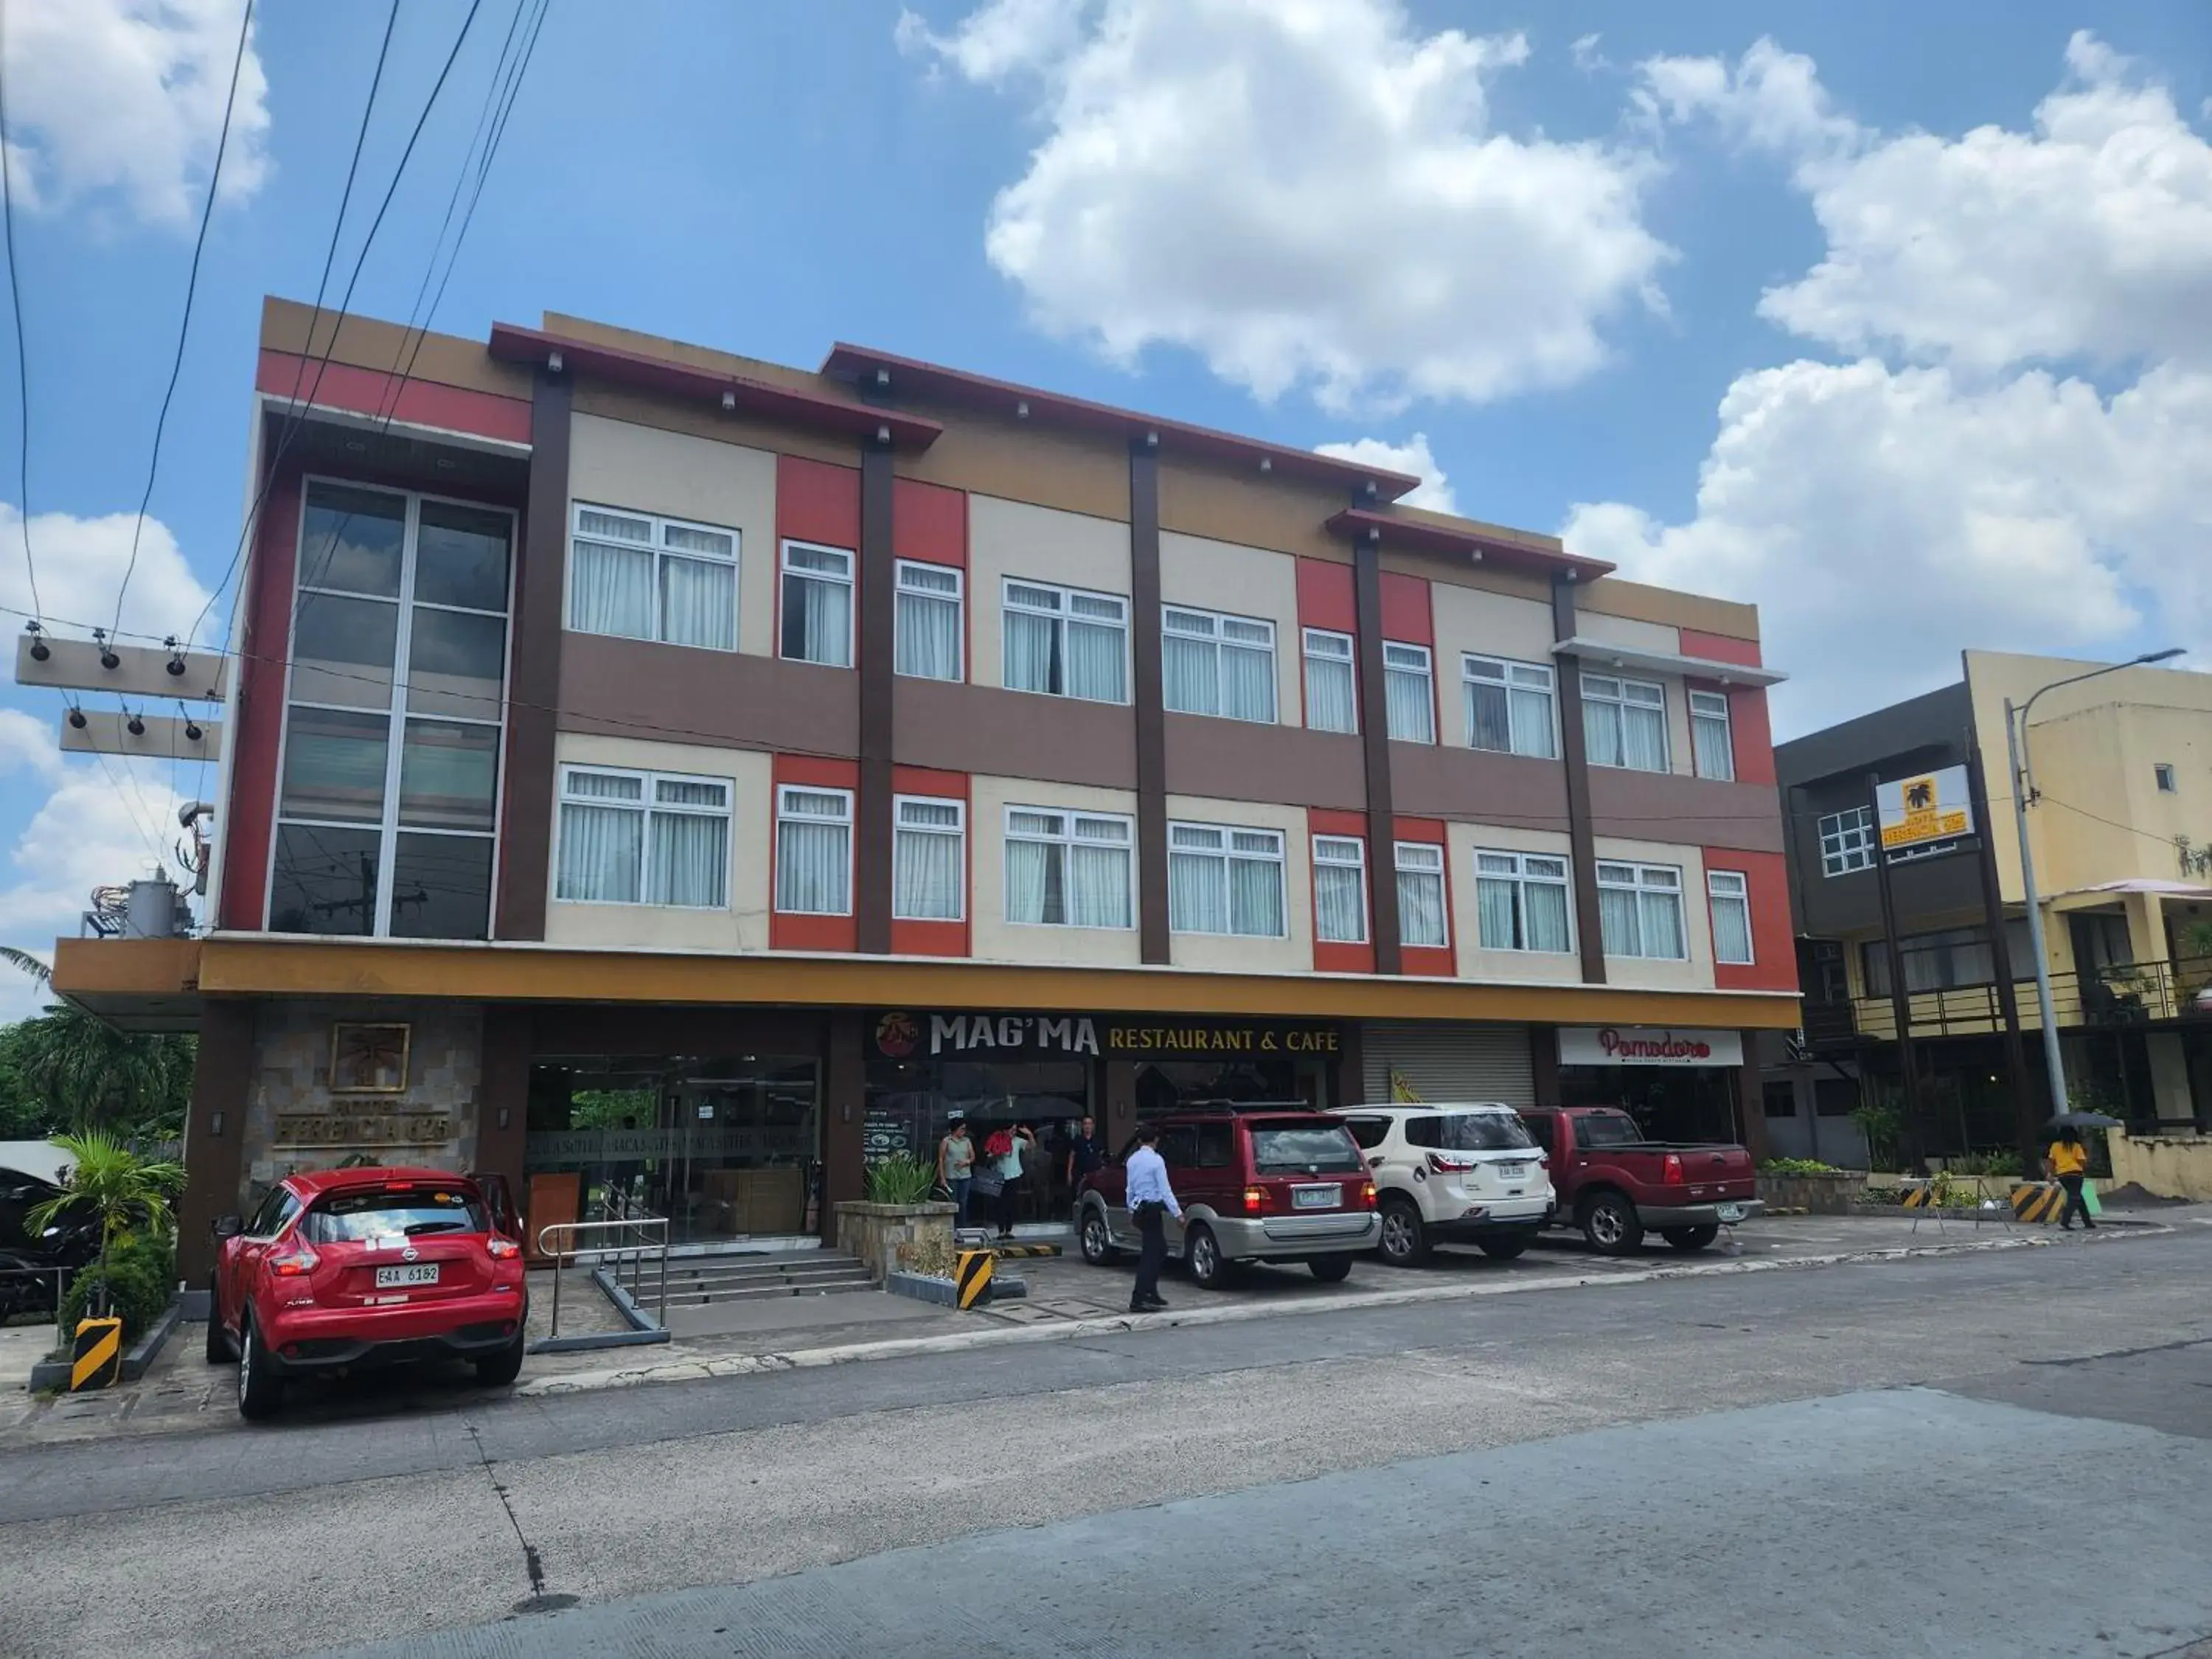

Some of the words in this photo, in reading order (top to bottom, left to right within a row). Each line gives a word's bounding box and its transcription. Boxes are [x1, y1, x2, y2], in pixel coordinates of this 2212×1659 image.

[1109, 1029, 1253, 1050] RESTAURANT
[1261, 1031, 1278, 1050] &
[378, 1270, 400, 1284] EAA
